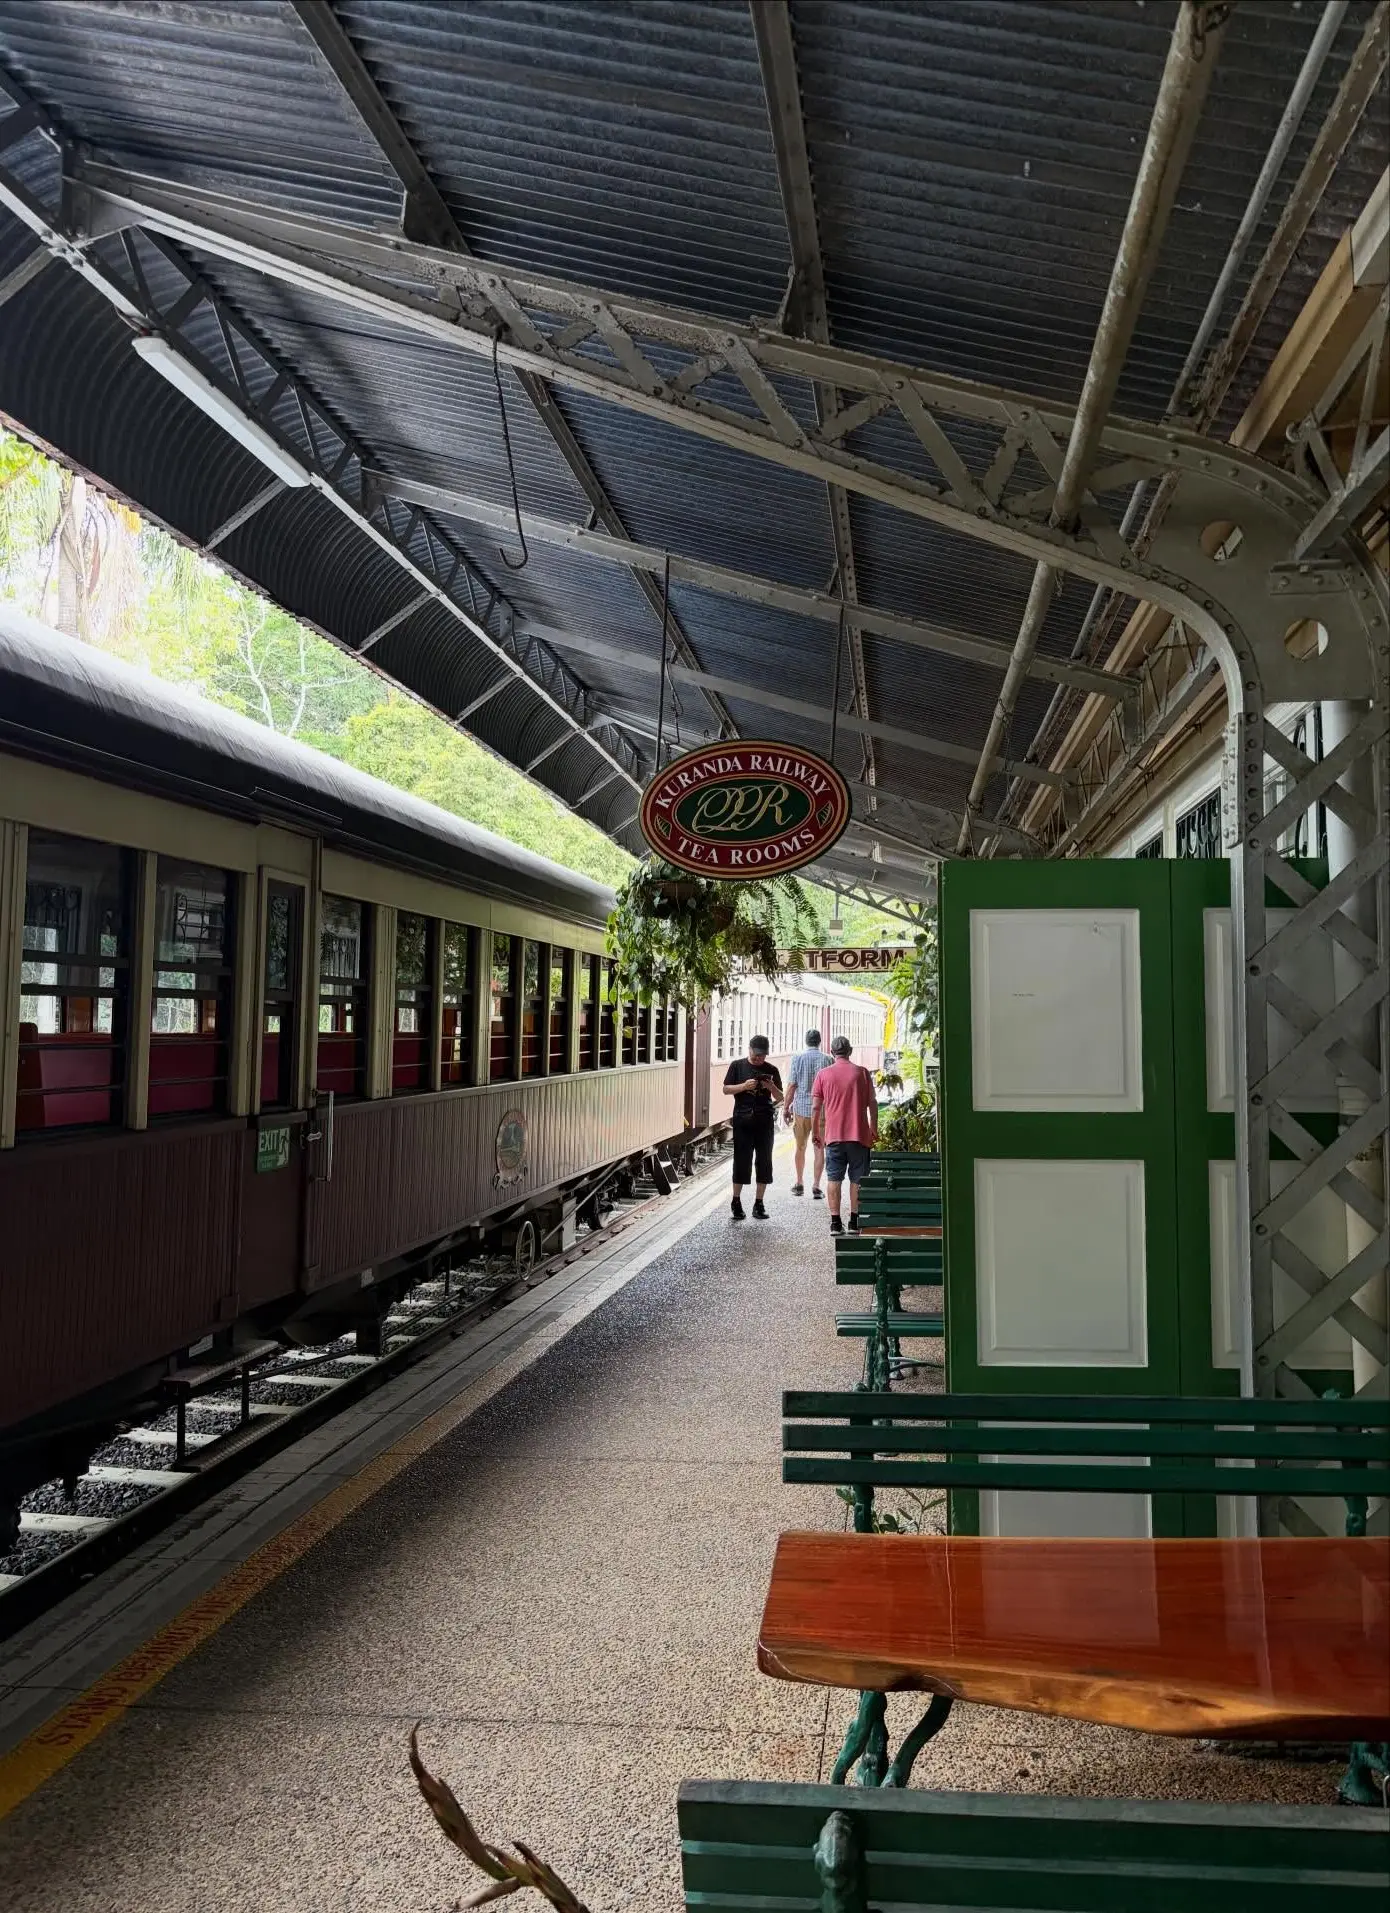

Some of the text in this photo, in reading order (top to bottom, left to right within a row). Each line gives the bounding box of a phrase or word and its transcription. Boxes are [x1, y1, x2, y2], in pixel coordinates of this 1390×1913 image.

[655, 754, 831, 809] KURANDA RAILWAY
[677, 828, 815, 865] TEA ROOMS
[260, 1130, 279, 1151] EXIT
[37, 1686, 128, 1746] STAND
